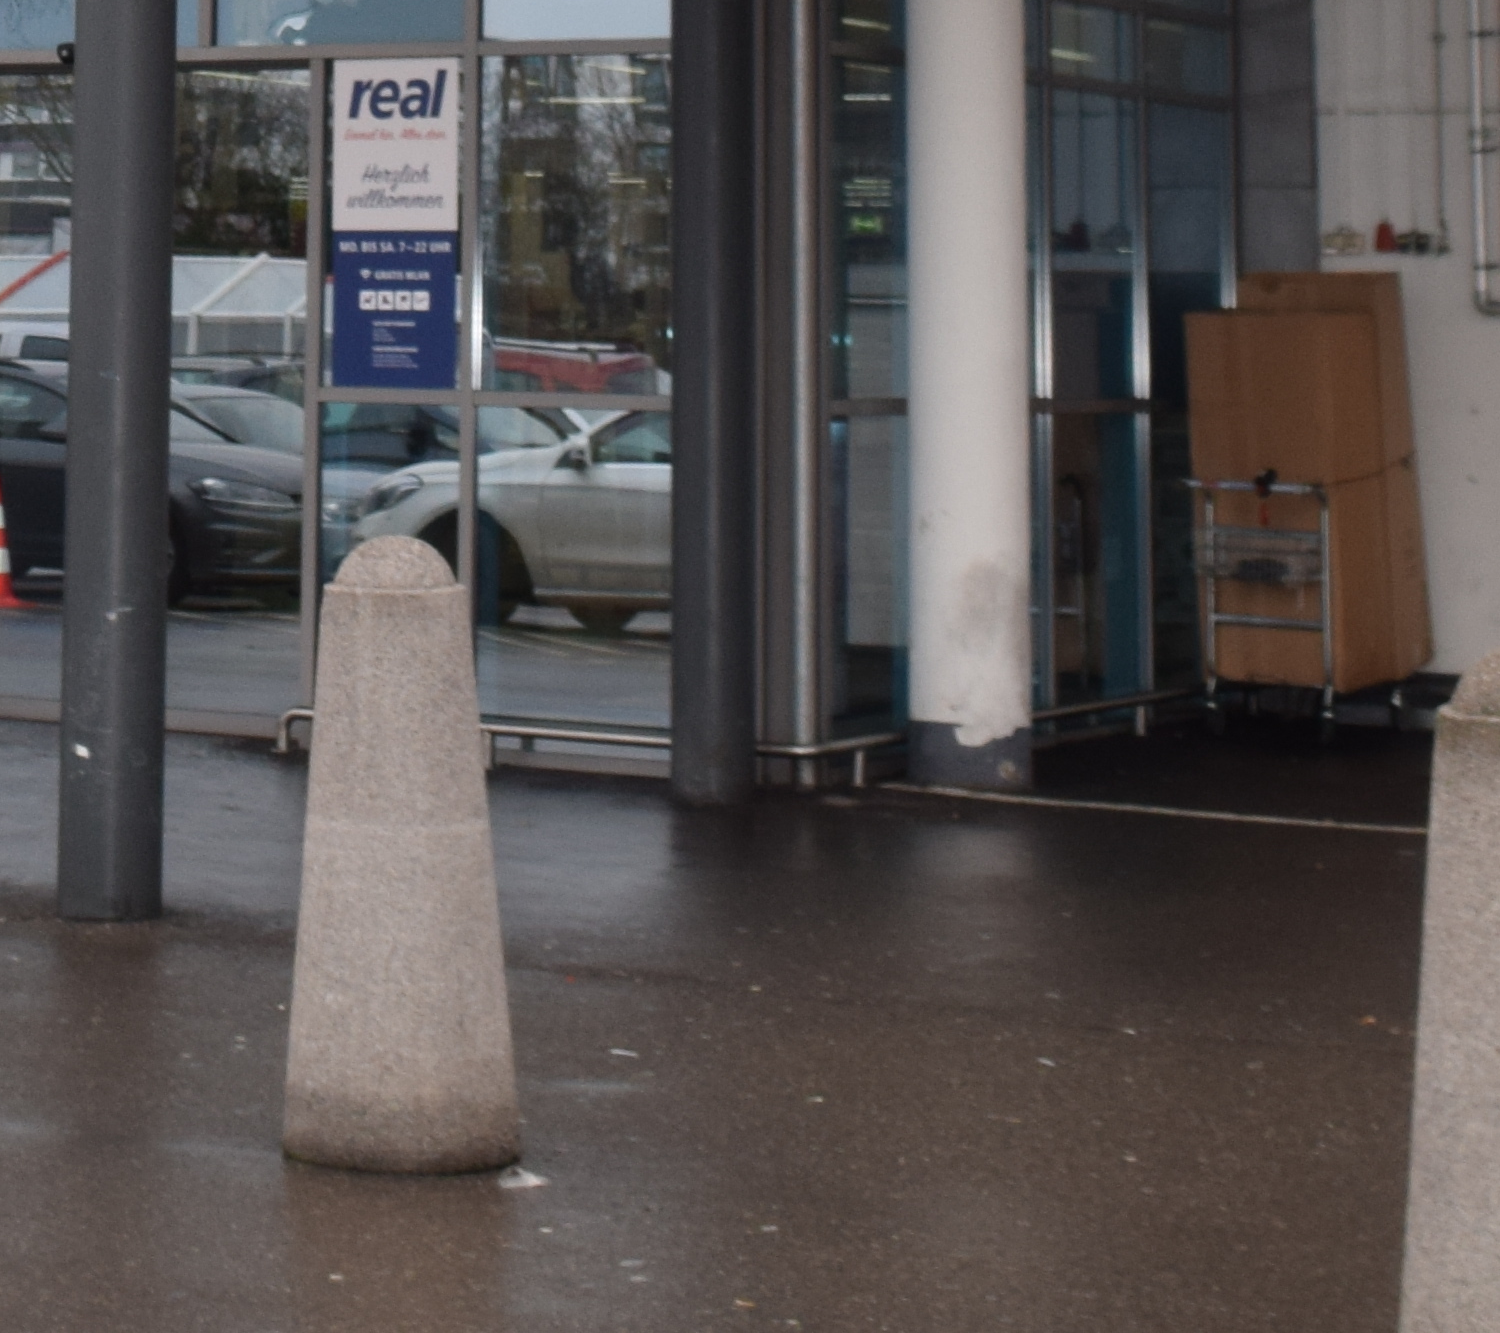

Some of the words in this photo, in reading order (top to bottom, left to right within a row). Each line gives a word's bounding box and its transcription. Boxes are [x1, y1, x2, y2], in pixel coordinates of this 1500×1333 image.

[349, 69, 448, 120] real
[360, 163, 430, 192] Herzlich
[346, 188, 444, 209] willkommen
